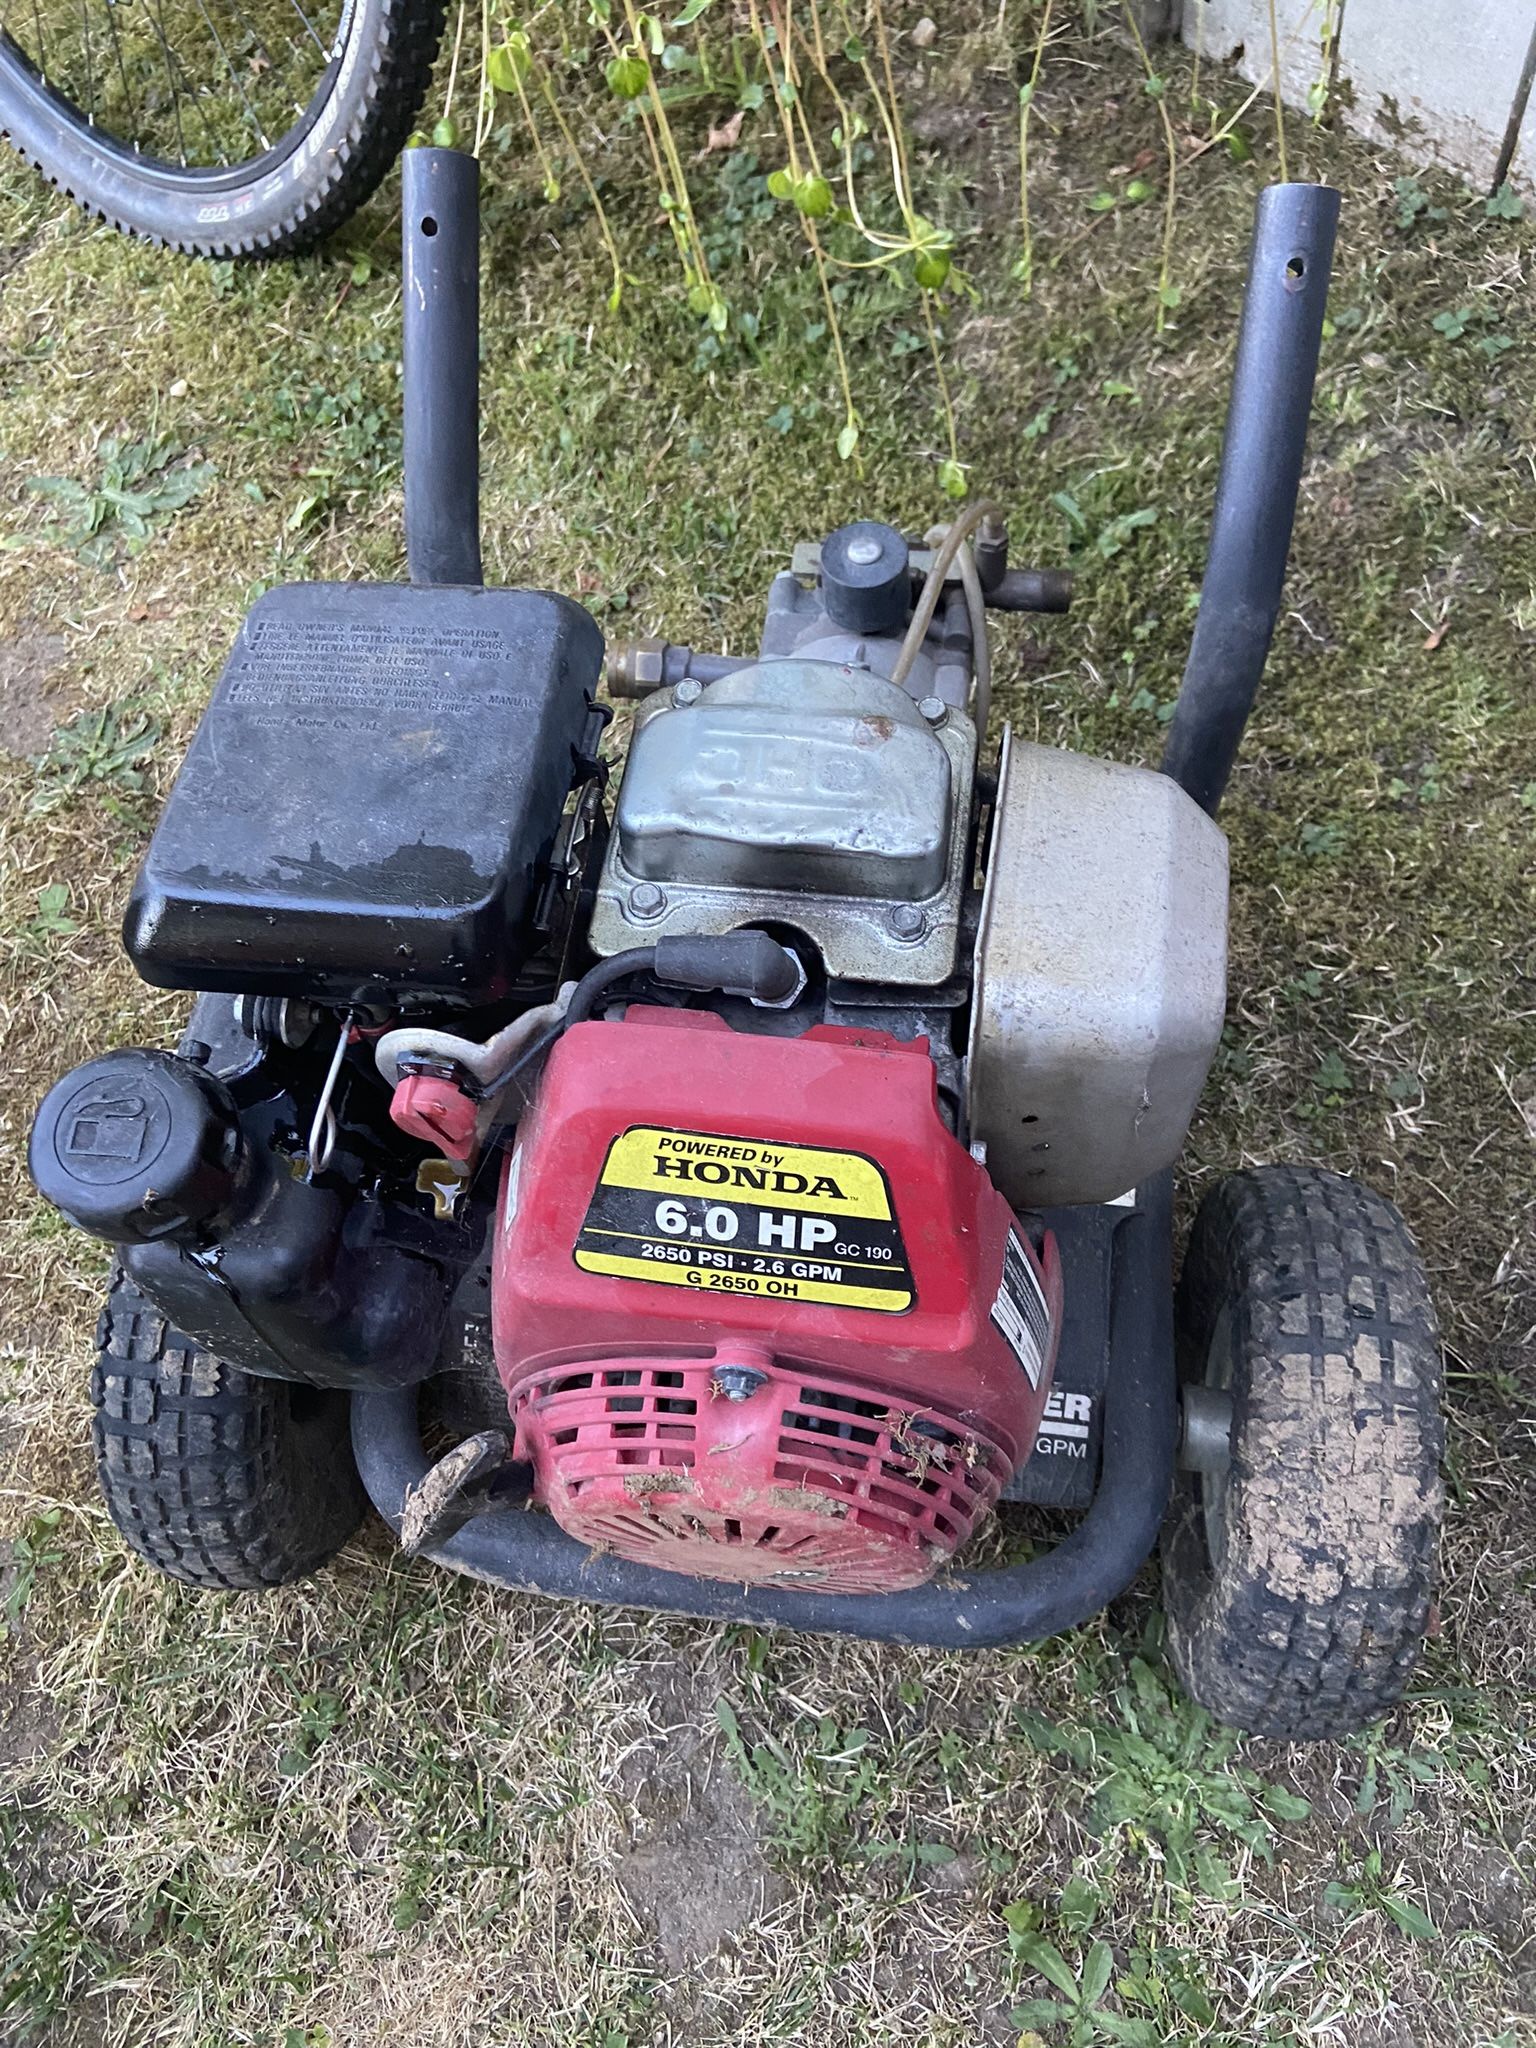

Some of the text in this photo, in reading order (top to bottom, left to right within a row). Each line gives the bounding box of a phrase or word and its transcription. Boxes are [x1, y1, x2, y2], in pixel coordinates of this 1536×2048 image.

[441, 628, 500, 639] OPERATION
[430, 637, 466, 648] AVANT
[471, 639, 505, 651] USAGE
[461, 649, 473, 659] DI
[479, 651, 500, 661] USO
[505, 653, 513, 661] E
[488, 694, 534, 708] MANUAL
[296, 718, 328, 728] Motor
[658, 1137, 785, 1167] POWERED by
[653, 1155, 848, 1200] HONDA
[654, 1199, 838, 1251] 6.0 HP
[834, 1242, 892, 1260] GC 190
[641, 1243, 842, 1282] 2650 PSI 2.6 GPM
[686, 1270, 799, 1297] G 2650 OH
[1035, 1437, 1088, 1459] GPM
